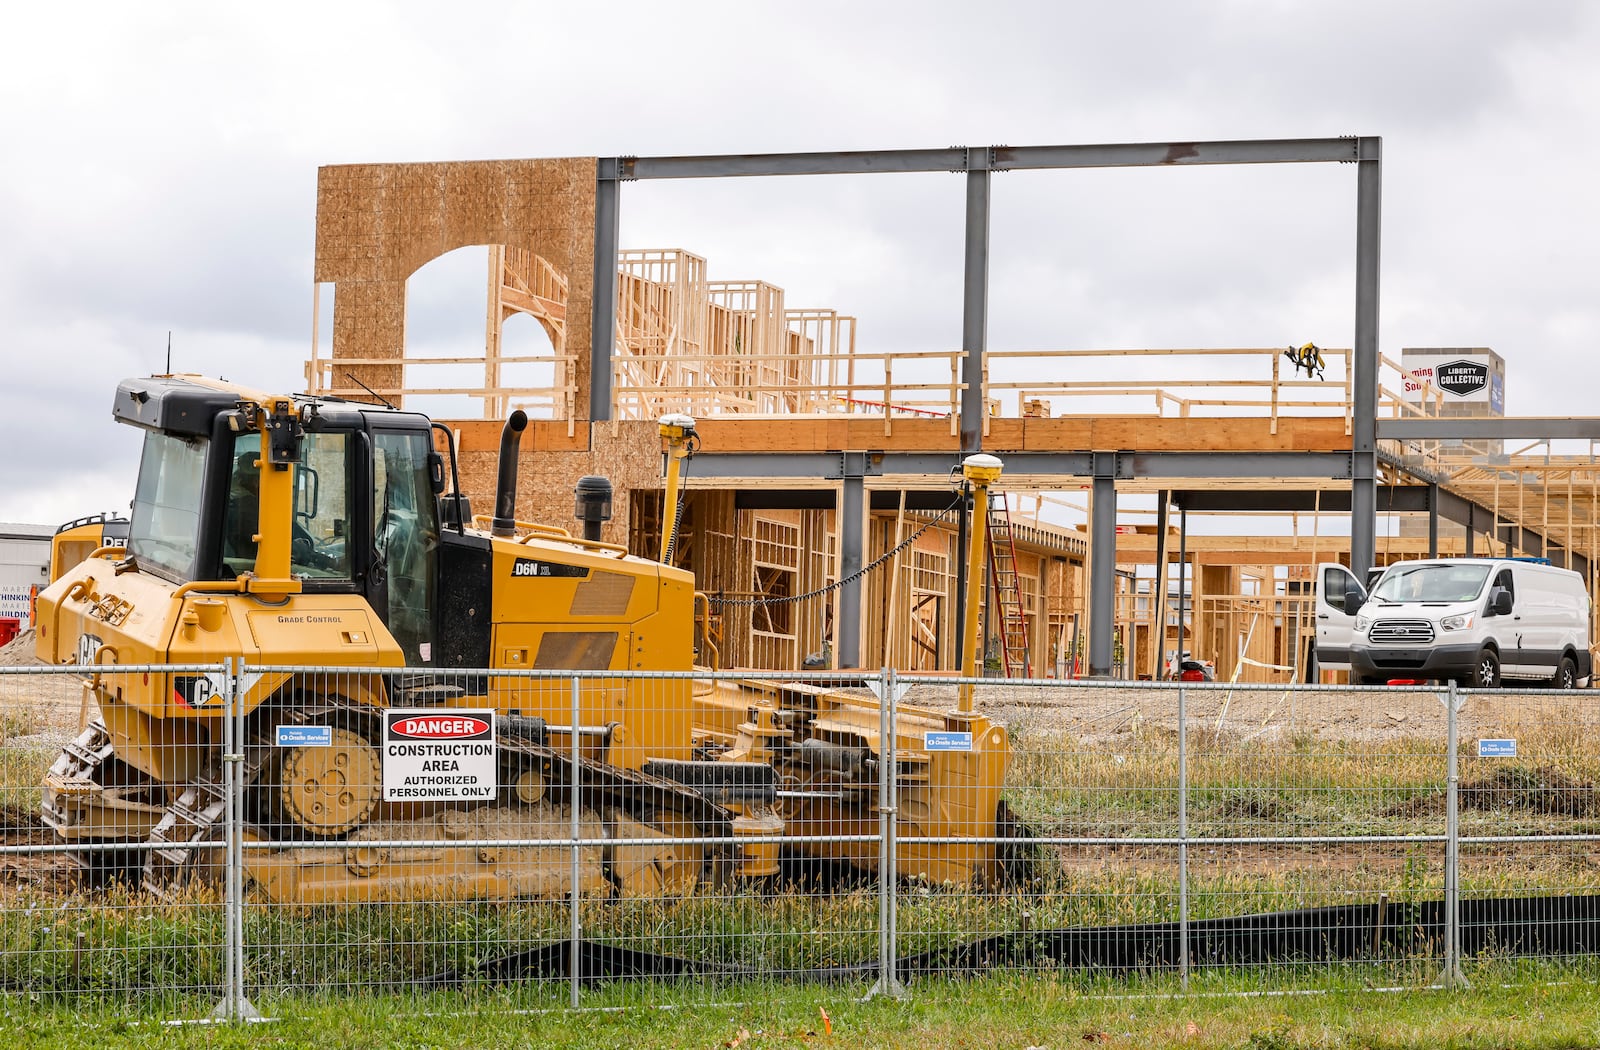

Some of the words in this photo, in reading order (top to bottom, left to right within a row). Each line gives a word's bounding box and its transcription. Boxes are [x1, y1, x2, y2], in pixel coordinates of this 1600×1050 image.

[1447, 367, 1477, 375] LIBERTY
[1440, 375, 1485, 385] COLLECTIVE
[515, 562, 538, 576] D6N
[406, 720, 475, 734] DANGER
[388, 744, 492, 756] CONSTRUCTION
[422, 760, 459, 771] AREA
[404, 775, 477, 785] AUTHORIZED
[389, 788, 458, 797] PERSONNEL
[461, 787, 491, 796] ONLY
